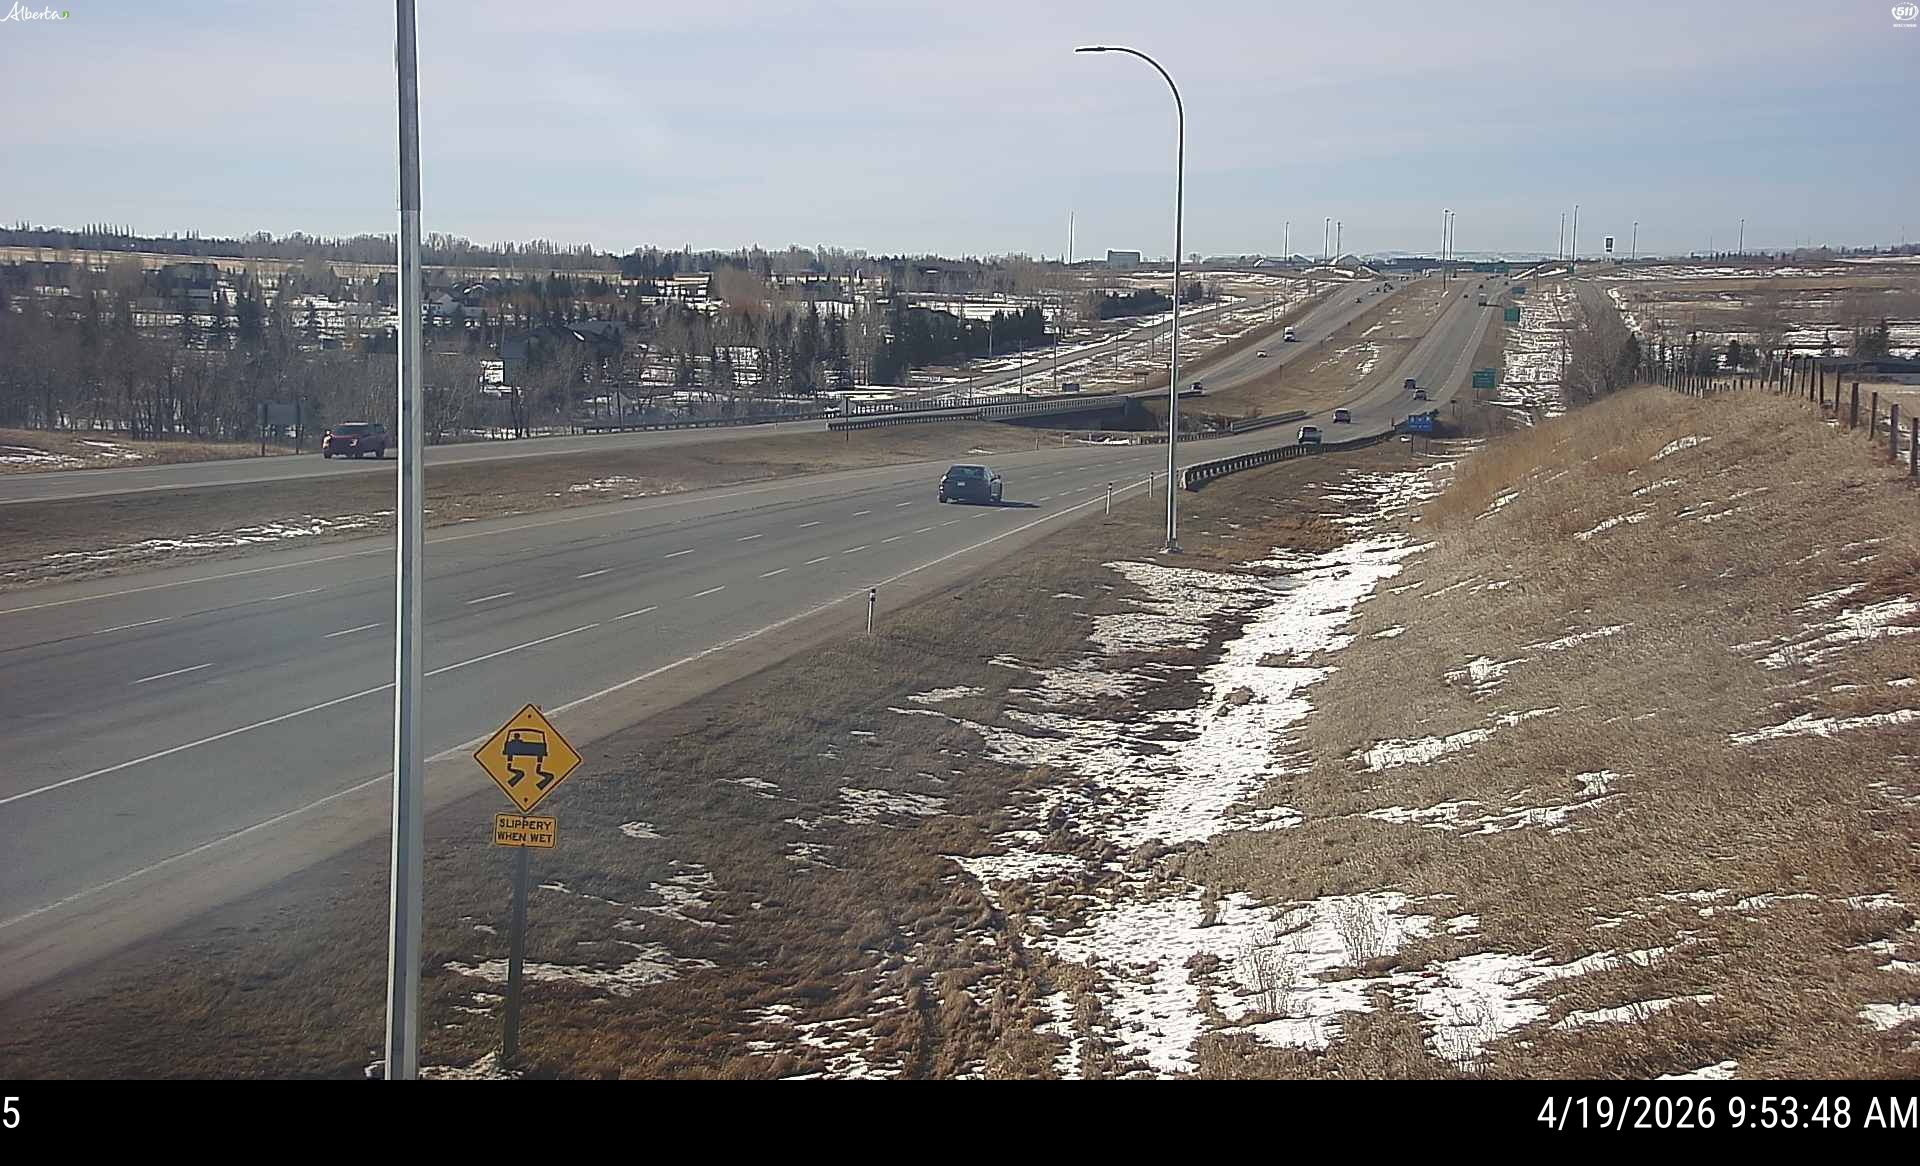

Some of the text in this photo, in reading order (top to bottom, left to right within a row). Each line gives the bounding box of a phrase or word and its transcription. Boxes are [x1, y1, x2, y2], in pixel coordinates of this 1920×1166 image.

[500, 818, 552, 830] SLIPPERY
[497, 831, 553, 843] WHEN WET
